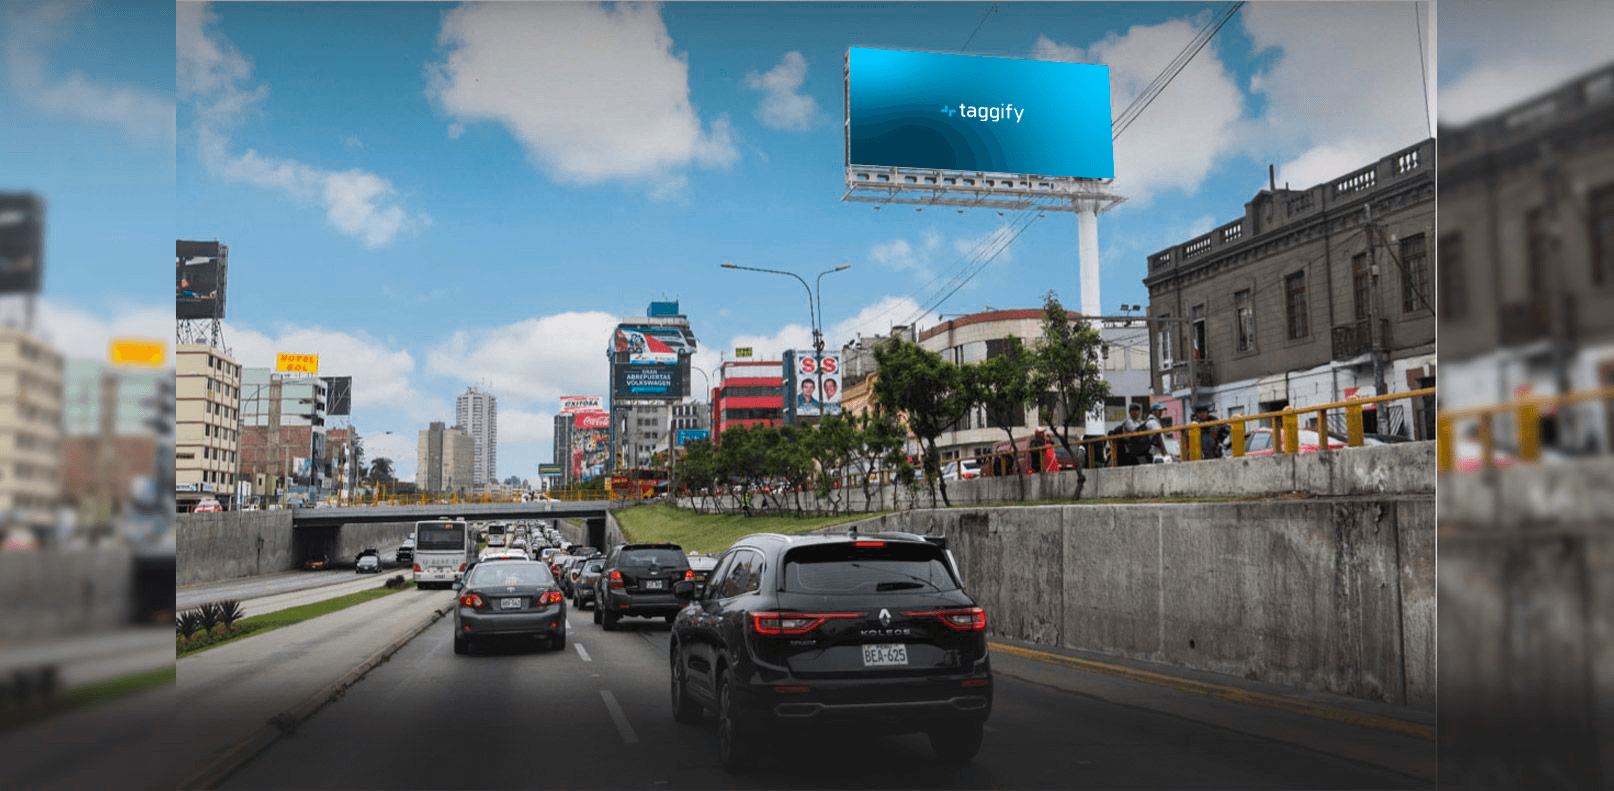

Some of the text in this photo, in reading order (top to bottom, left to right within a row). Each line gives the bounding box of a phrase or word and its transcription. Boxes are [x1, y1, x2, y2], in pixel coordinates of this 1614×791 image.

[959, 103, 1025, 123] taggify
[280, 354, 315, 364] HOTEL
[286, 363, 308, 372] SOL
[860, 628, 911, 637] KOLEOS
[865, 649, 906, 663] BEA-625
